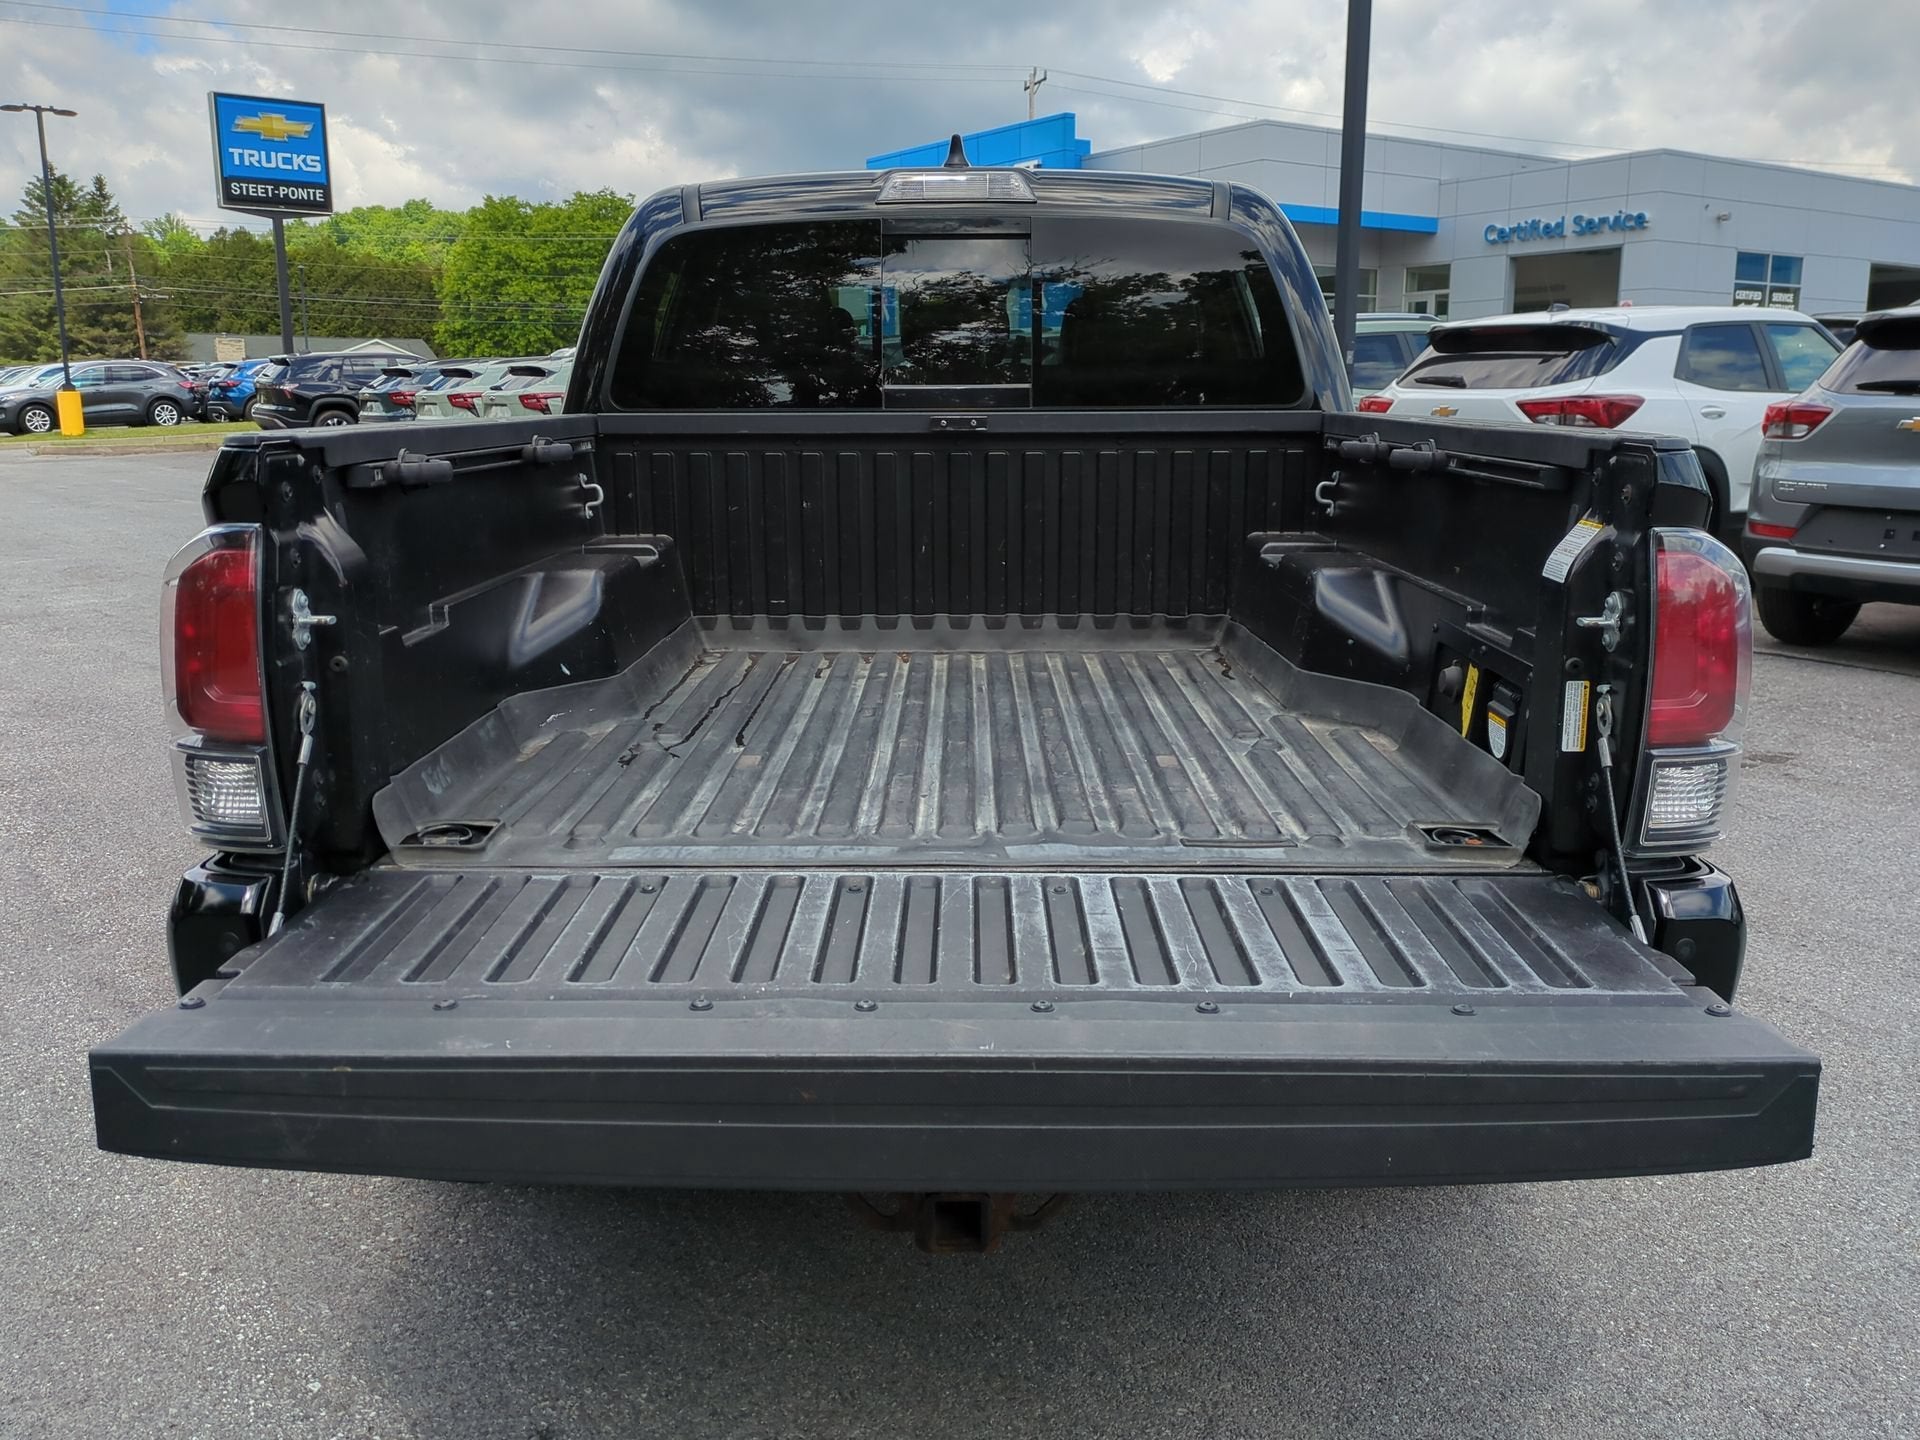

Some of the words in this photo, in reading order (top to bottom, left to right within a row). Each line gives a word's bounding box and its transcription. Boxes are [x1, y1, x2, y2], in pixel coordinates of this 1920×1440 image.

[228, 147, 322, 172] TRUCKS
[230, 182, 325, 202] STEET-PONTE
[1484, 216, 1567, 244] Certified
[1572, 209, 1650, 236] Service
[1735, 289, 1762, 300] CERTIFIED
[1772, 292, 1794, 303] SERVICE
